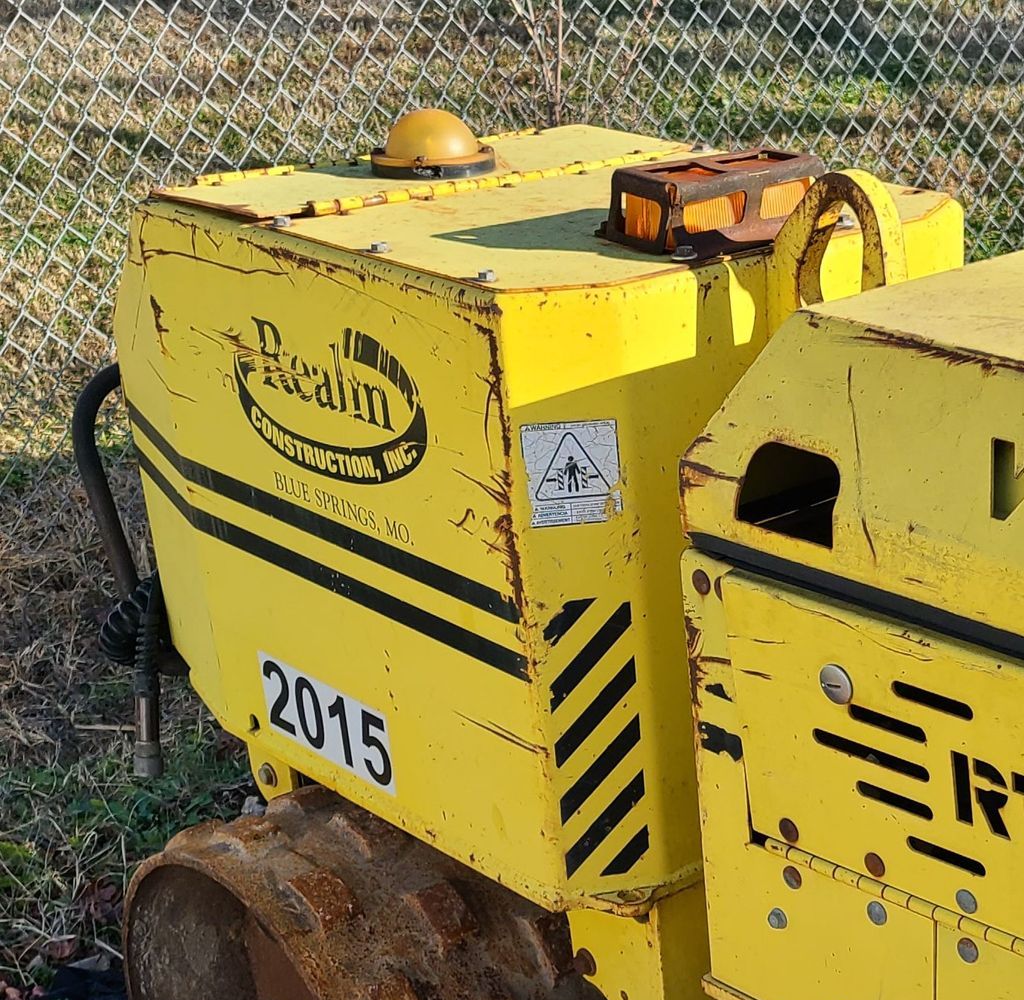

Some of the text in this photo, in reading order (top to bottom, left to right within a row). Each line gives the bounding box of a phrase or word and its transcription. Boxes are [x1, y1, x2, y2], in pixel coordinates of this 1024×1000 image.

[251, 315, 396, 433] Realm
[251, 405, 418, 482] CONSTRUCTION, INC.
[274, 471, 415, 547] BLUE SPRINGS, MO.
[263, 660, 392, 786] 2015
